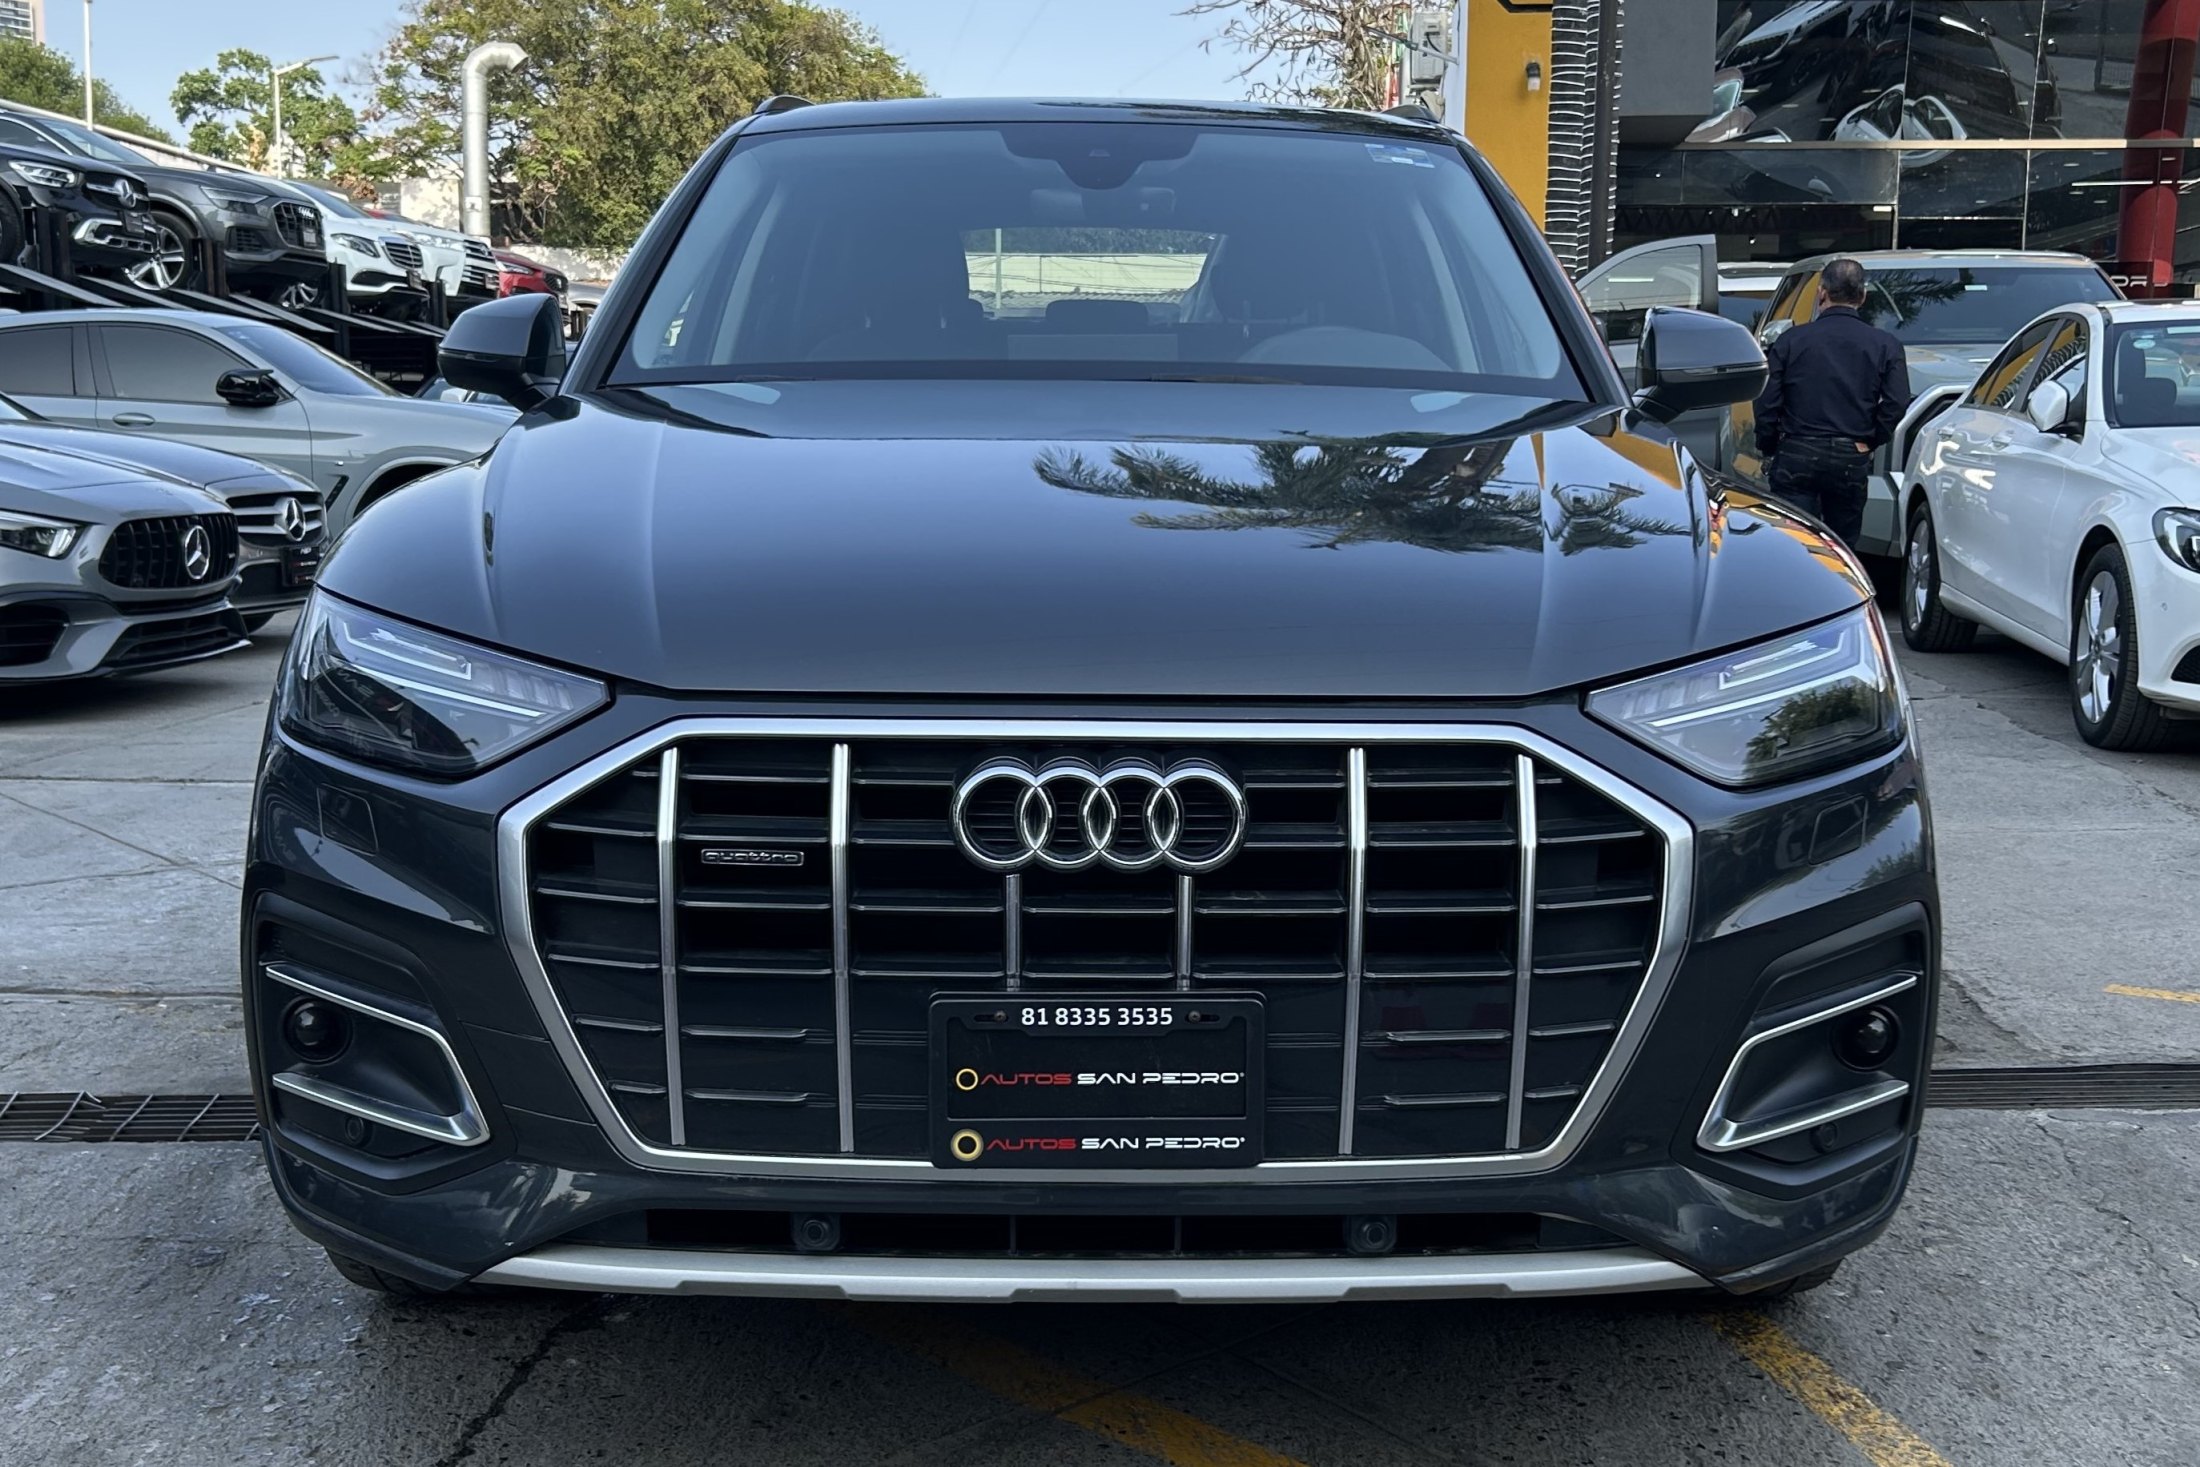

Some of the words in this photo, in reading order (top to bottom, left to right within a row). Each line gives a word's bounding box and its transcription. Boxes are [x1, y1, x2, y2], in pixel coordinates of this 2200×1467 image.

[704, 851, 799, 863] quattro
[1021, 1007, 1049, 1026] 81
[1055, 1007, 1111, 1026] 8335
[1117, 1007, 1173, 1026] 3535
[981, 1073, 1072, 1085] AUTOS
[1077, 1072, 1136, 1085] SAN
[987, 1138, 1076, 1150] AUTOS
[1081, 1137, 1139, 1149] SAN
